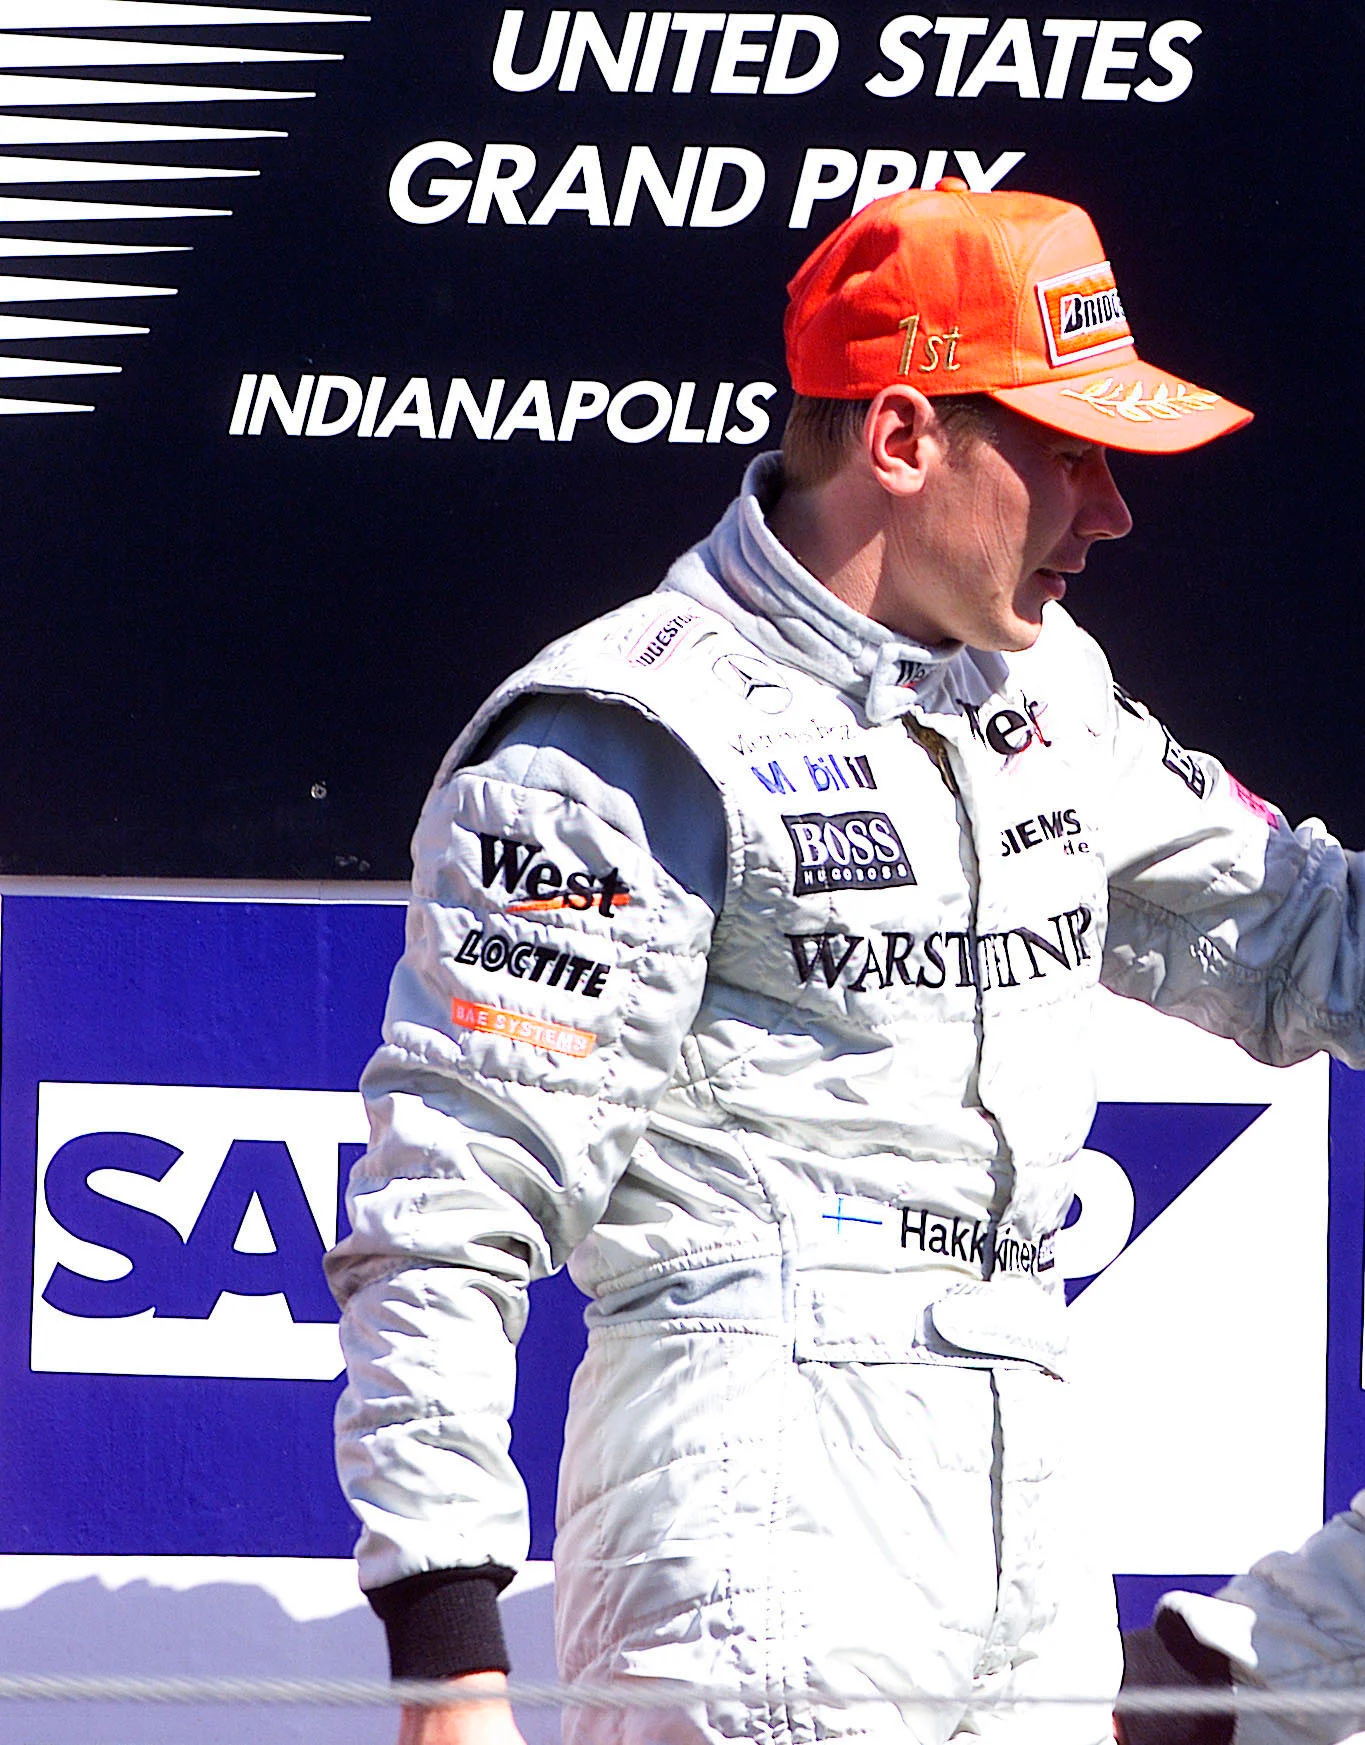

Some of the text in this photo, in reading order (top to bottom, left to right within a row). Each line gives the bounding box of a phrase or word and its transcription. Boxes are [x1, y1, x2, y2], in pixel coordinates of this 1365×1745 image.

[491, 9, 1203, 103] UNITED STATES
[388, 140, 766, 228] GRAND
[898, 312, 963, 376] 1st
[229, 373, 777, 445] INDIANAPOLIS
[479, 832, 631, 919] West
[790, 817, 901, 867] BOSS
[453, 928, 612, 998] LOCTITE
[455, 1003, 589, 1054] BAE SYSTEMS
